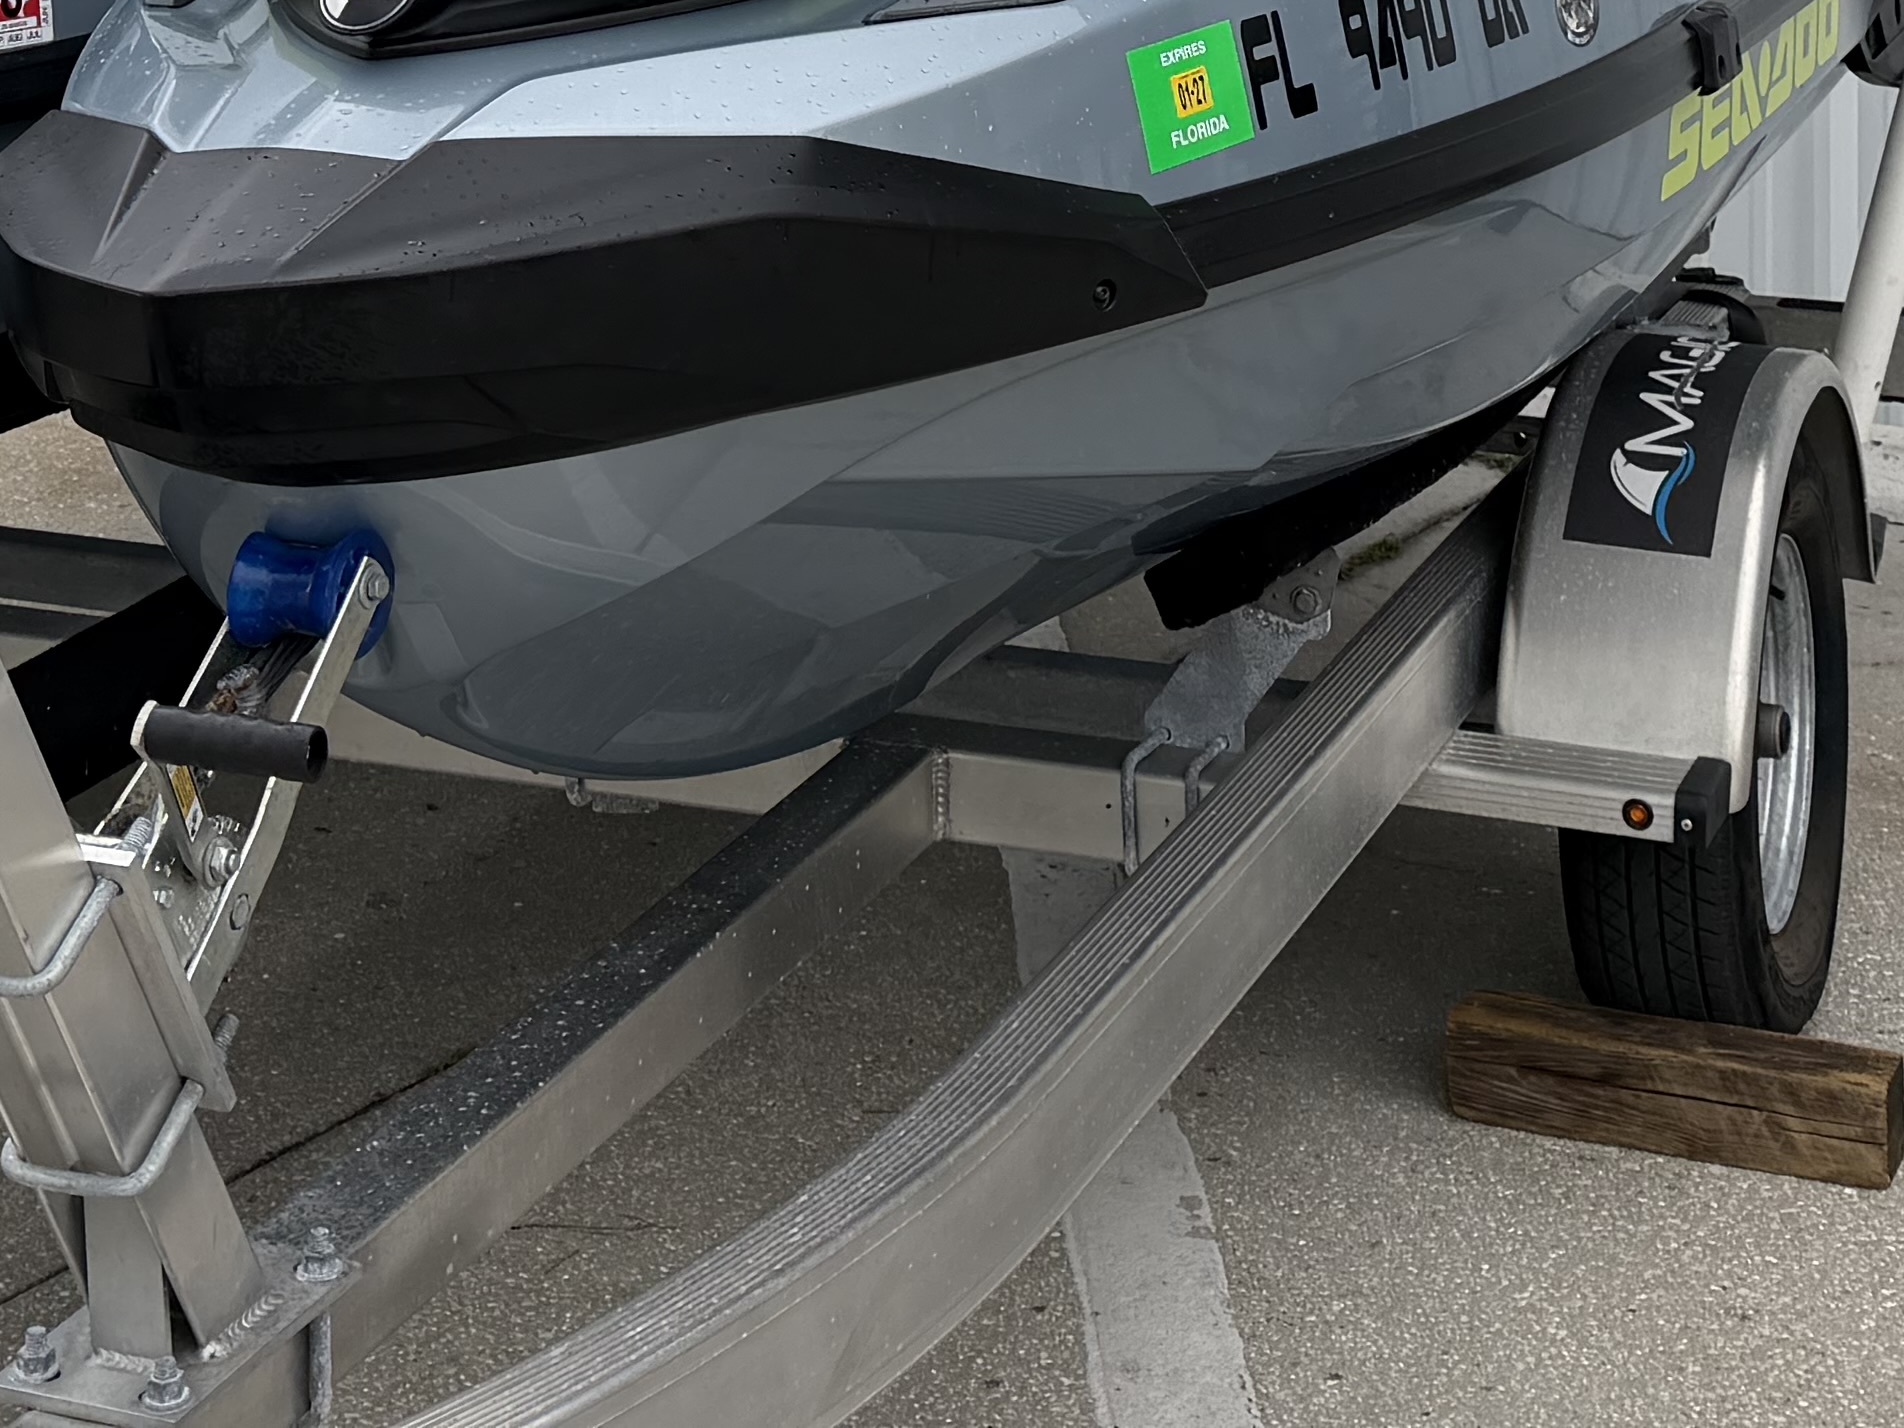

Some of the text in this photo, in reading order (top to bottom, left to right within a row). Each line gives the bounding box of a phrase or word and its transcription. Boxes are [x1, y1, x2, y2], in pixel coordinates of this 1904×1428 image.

[1159, 40, 1207, 67] EXPIRES
[1240, 10, 1318, 130] FL
[1170, 114, 1230, 149] FLORIDA
